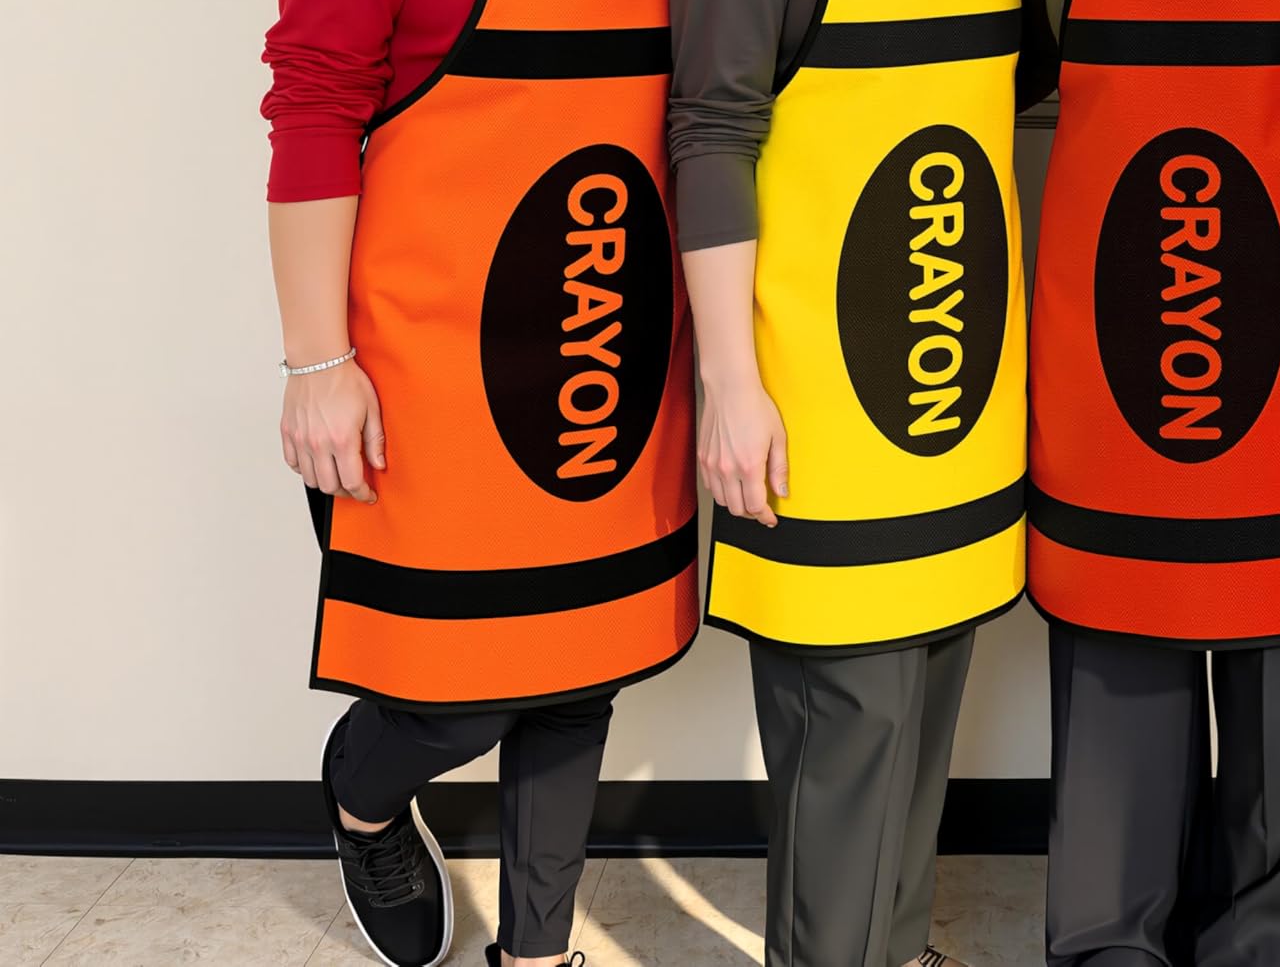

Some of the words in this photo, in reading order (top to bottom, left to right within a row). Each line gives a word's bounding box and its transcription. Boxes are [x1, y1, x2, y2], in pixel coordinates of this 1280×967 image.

[556, 173, 629, 480] CRAYON
[908, 152, 965, 436] CRAYON
[1159, 154, 1222, 441] CRAYON
